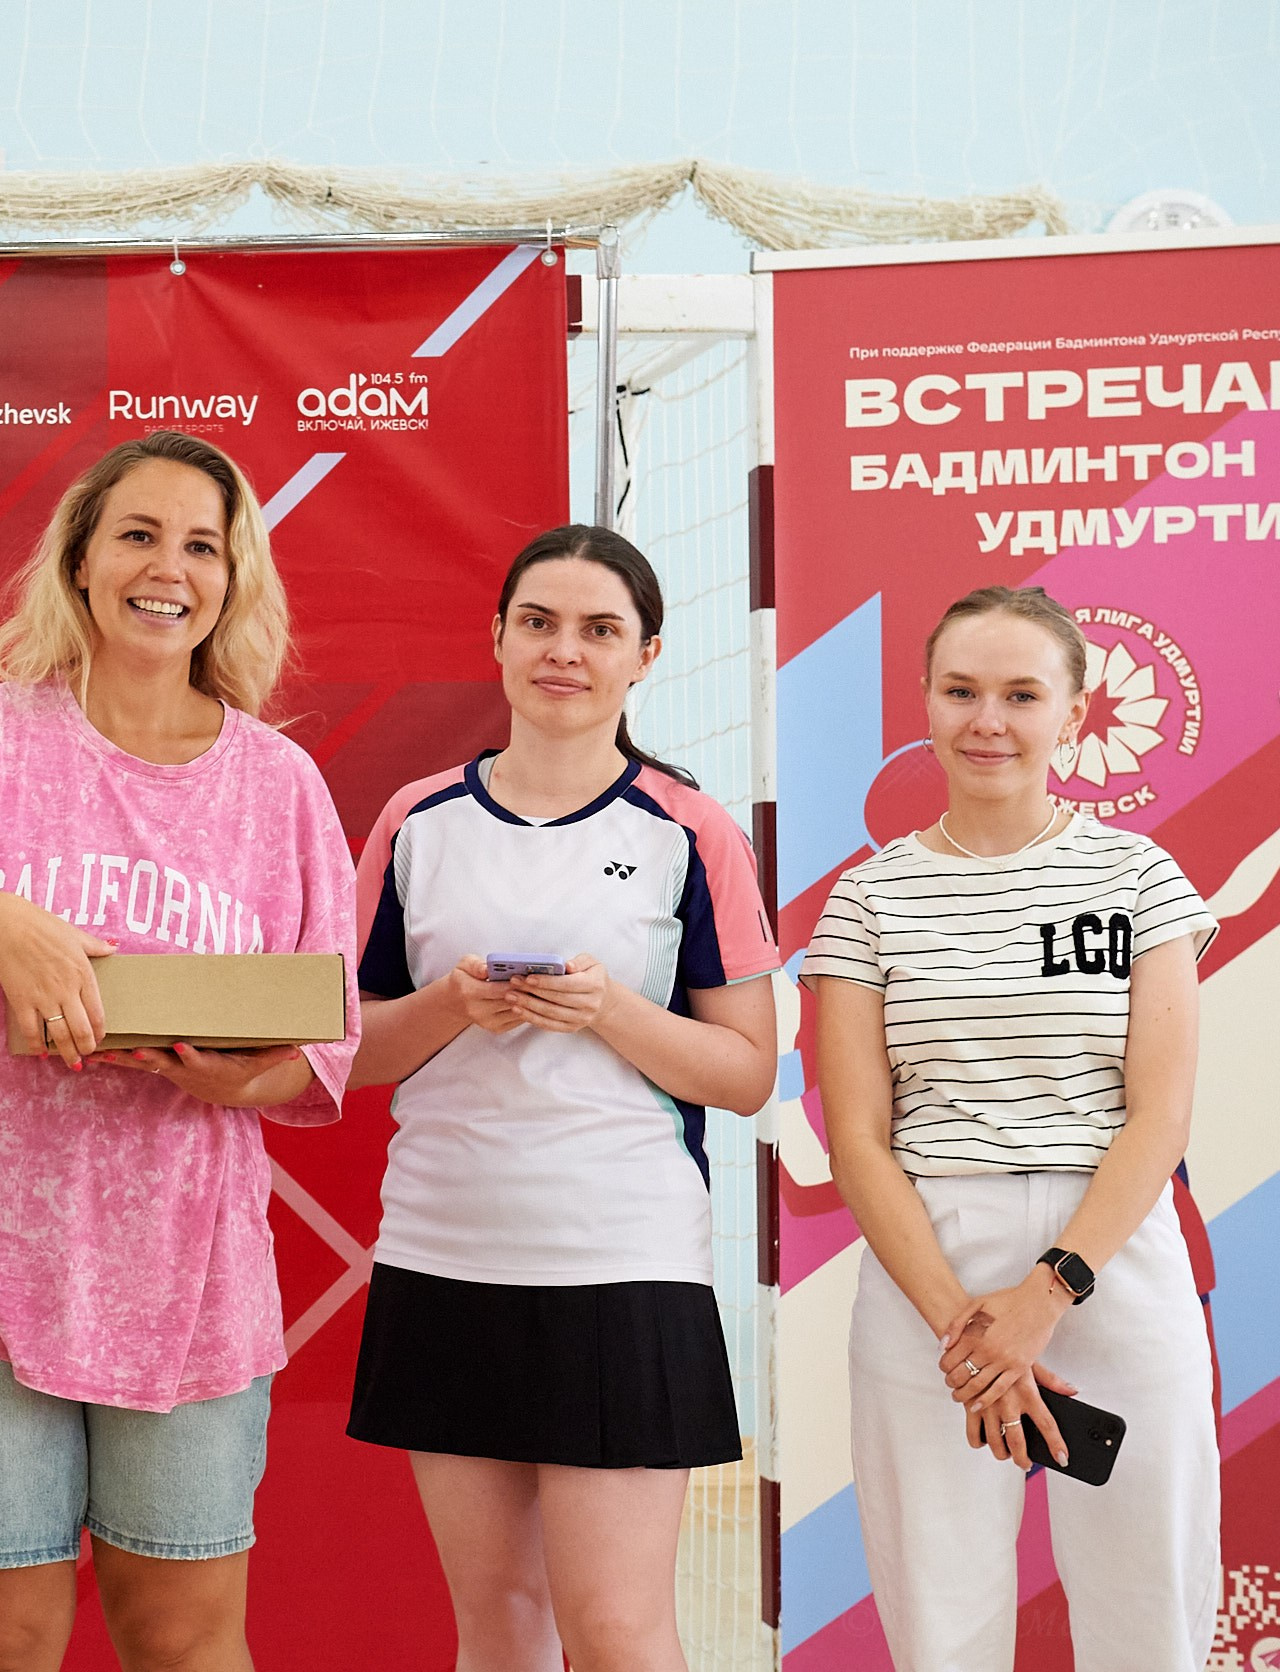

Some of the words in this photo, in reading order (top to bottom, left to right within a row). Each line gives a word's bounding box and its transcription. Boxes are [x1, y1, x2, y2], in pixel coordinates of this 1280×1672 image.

[849, 346, 879, 360] При
[882, 343, 964, 357] поддержке
[967, 338, 1052, 354] Федерации
[1055, 334, 1146, 350] Бадминтона
[1150, 328, 1239, 346] Удмуртской
[371, 372, 404, 385] 104.5
[408, 371, 428, 384] fm
[844, 360, 1280, 428] ВСТРЕЧА
[109, 390, 259, 426] Runway
[849, 440, 1255, 496] БАДМИНТОН
[975, 502, 1280, 556] УДМУРТИ
[1094, 608, 1155, 640] ЛИГА
[1152, 632, 1201, 756] УДМУРТИИ
